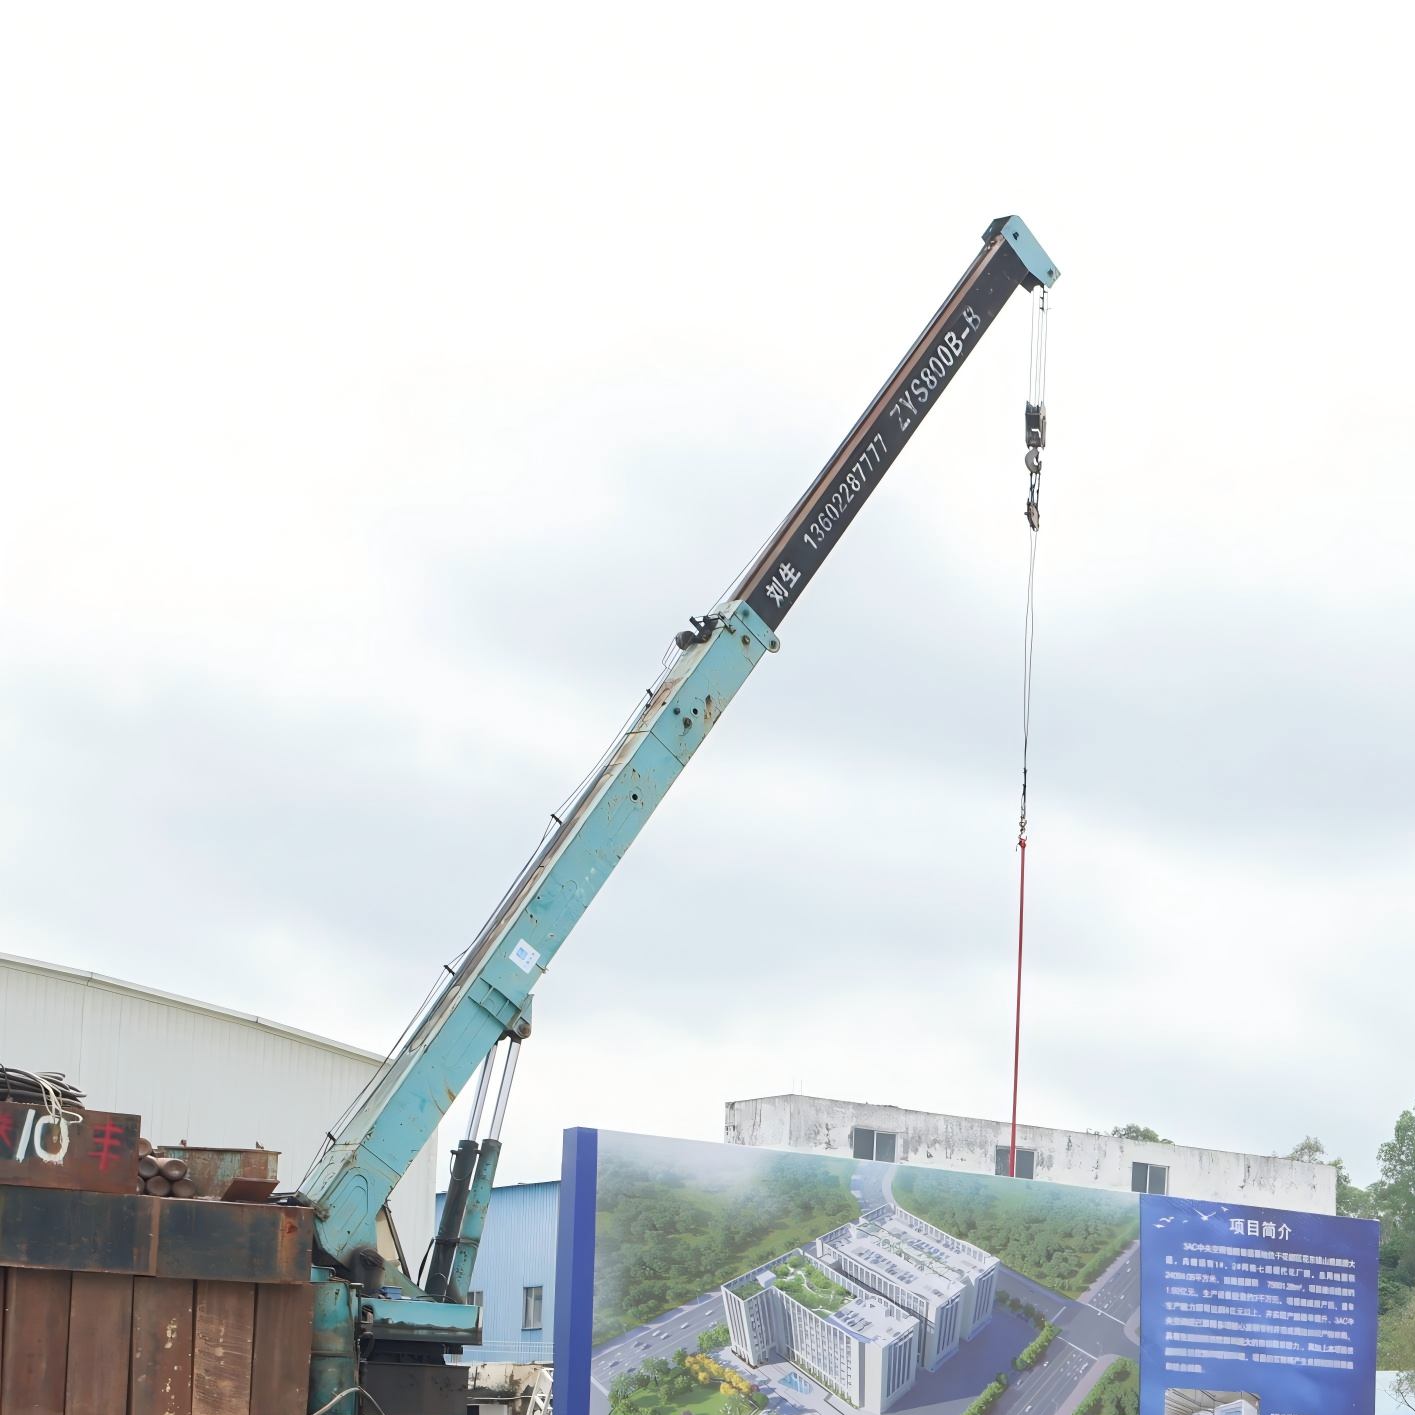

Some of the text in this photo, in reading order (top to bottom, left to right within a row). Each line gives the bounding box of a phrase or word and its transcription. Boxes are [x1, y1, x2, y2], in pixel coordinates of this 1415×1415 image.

[766, 561, 802, 608] 刘生
[803, 432, 888, 550] 13602287777
[1229, 1218, 1292, 1241] 项目简介
